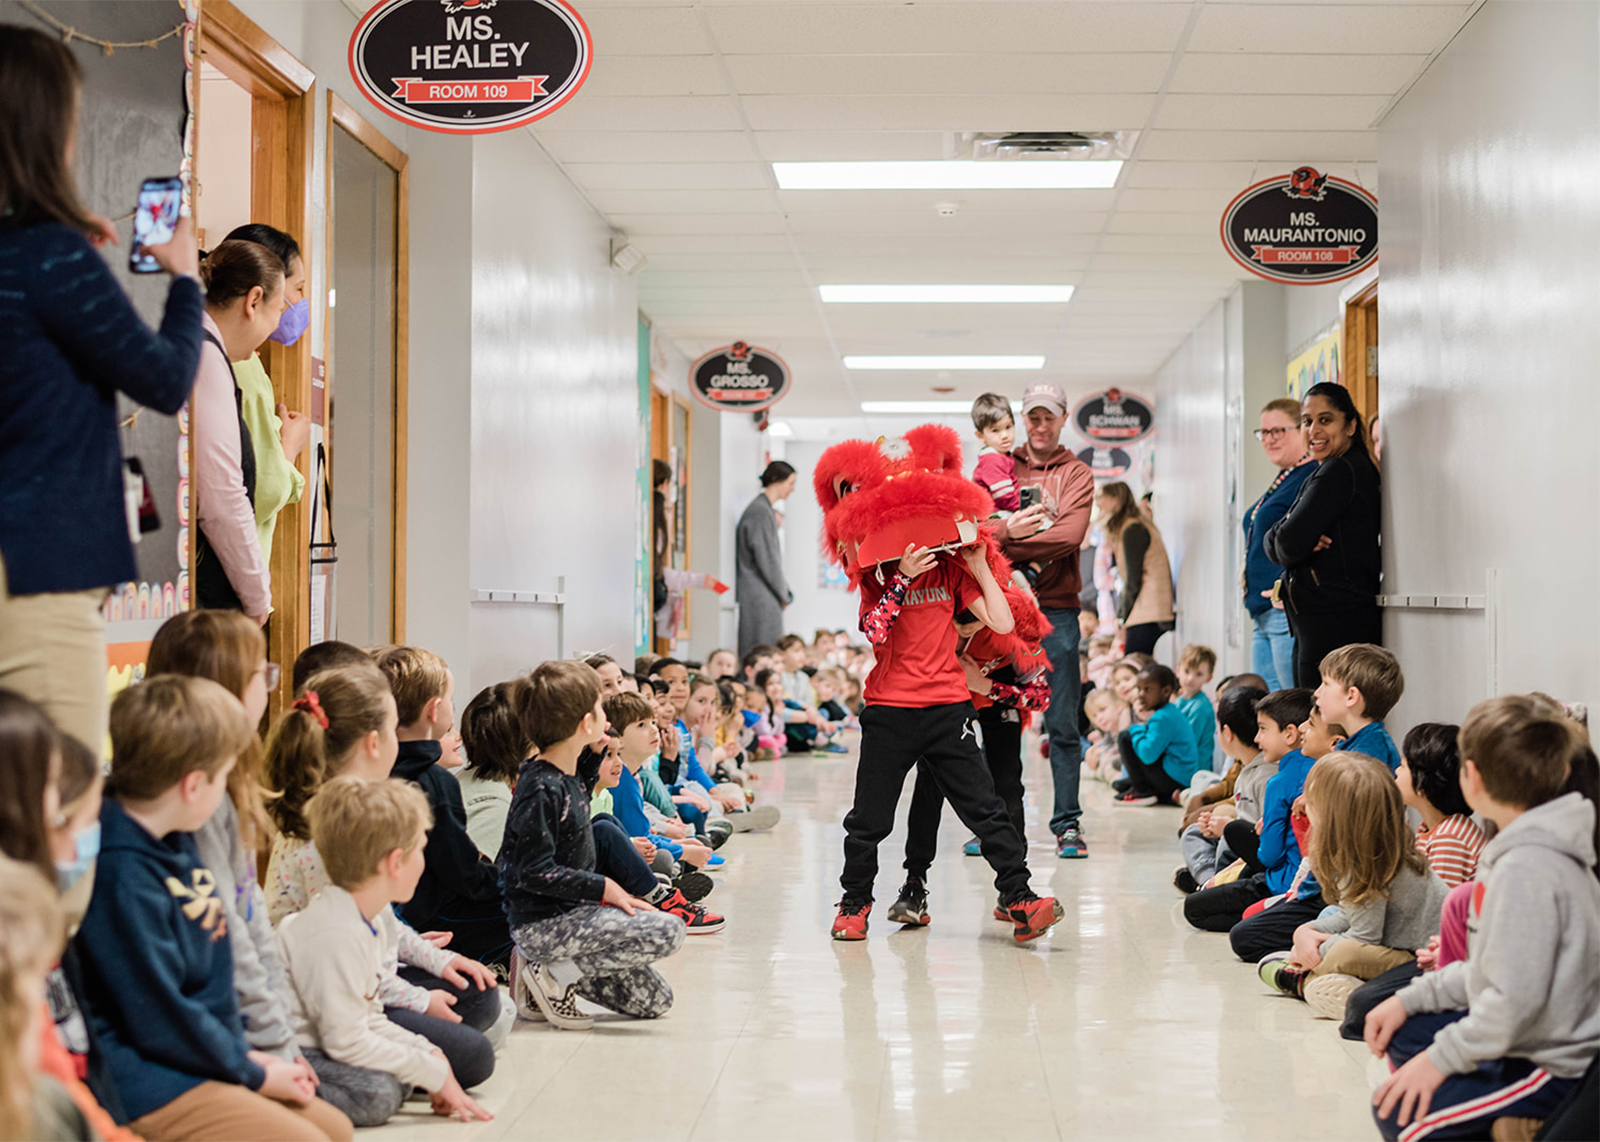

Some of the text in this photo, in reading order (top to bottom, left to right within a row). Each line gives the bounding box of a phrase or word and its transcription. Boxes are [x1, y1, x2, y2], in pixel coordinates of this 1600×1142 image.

[446, 15, 501, 41] MS.
[411, 42, 530, 70] HEALEY
[429, 85, 508, 99] ROOM 109
[1290, 212, 1320, 226] MS.
[1244, 228, 1367, 243] MAURANTONIO
[1278, 251, 1334, 261] ROOM 108
[727, 362, 752, 374] MS.
[710, 374, 769, 388] GROSSO
